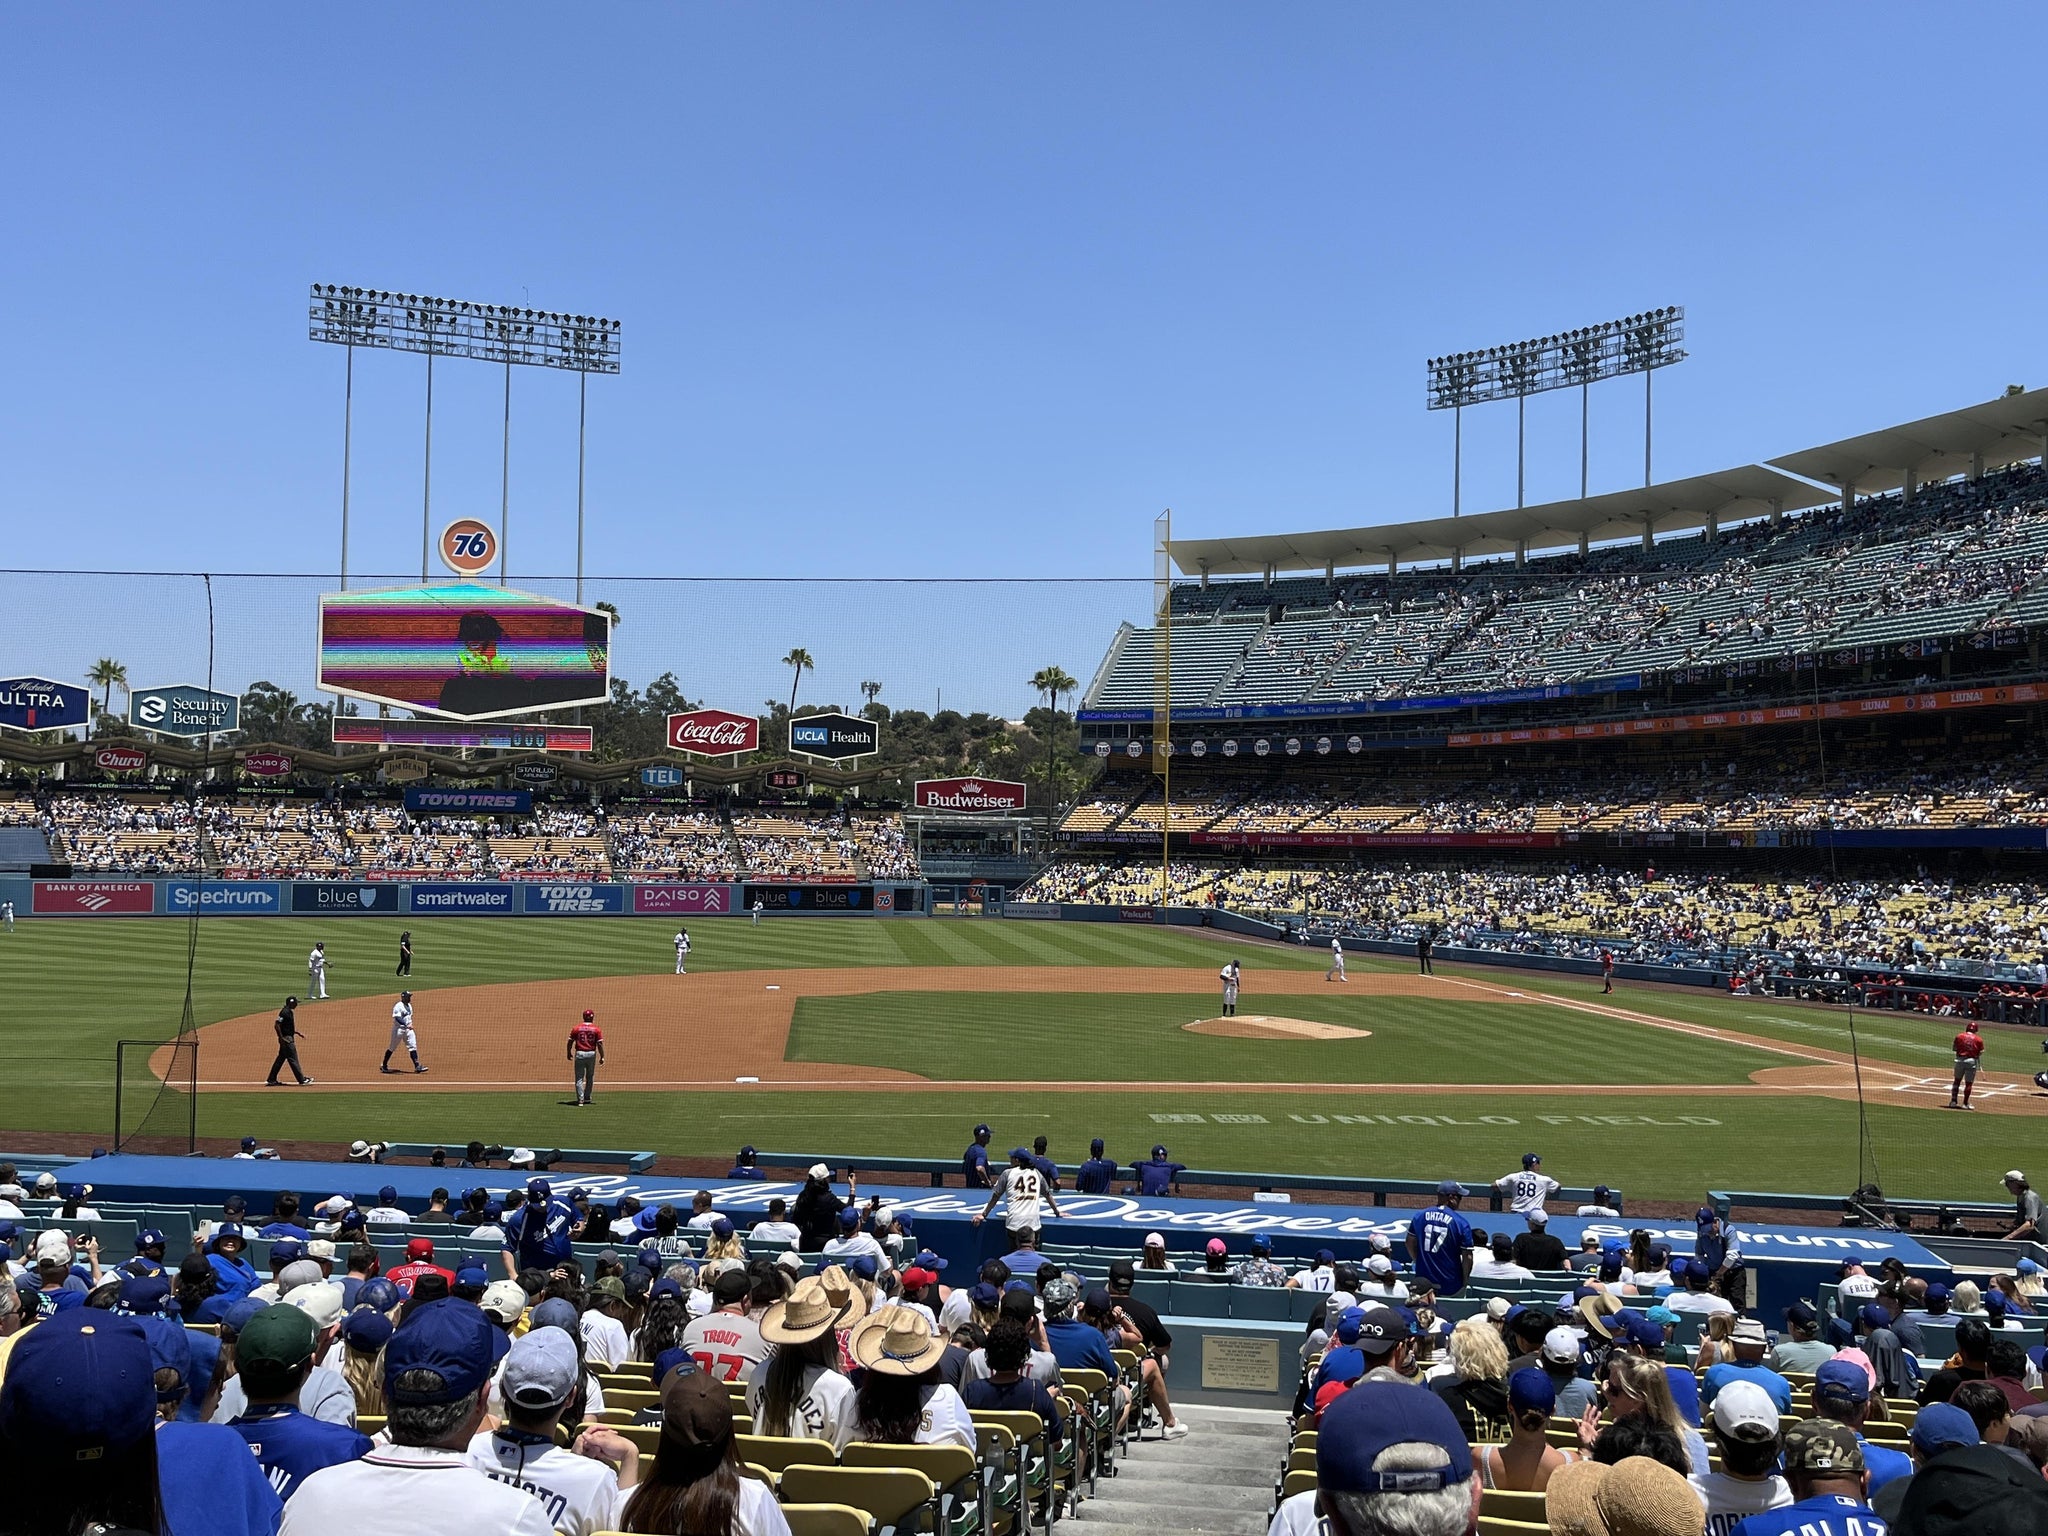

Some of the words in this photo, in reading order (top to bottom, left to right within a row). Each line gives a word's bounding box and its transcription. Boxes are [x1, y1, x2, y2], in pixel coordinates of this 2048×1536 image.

[453, 532, 488, 559] 76
[10, 680, 55, 692] Michelob
[0, 691, 65, 708] ULTRA
[172, 696, 230, 716] Security
[172, 711, 221, 726] Beneit
[676, 719, 750, 745] Coca-Cola
[796, 730, 825, 742] UCLA
[831, 730, 871, 744] Health
[98, 752, 145, 767] Churu
[247, 759, 278, 767] DAISO
[388, 761, 402, 775] JIM
[517, 766, 555, 775] STARLUX
[646, 769, 678, 783] TEL
[418, 793, 468, 807] TOYO
[468, 795, 518, 808] TIRES
[926, 791, 1015, 808] Budweiser
[1055, 832, 1071, 842] 1:10
[46, 884, 76, 892] BANK
[78, 884, 92, 892] OF
[94, 884, 141, 892] AMERICA
[318, 887, 358, 904] blue
[540, 886, 593, 899] TOYO
[644, 889, 699, 901] DAISO
[174, 887, 267, 909] Spectrum
[416, 891, 507, 906] smartwater
[755, 889, 787, 903] blue
[815, 890, 847, 904] blue
[877, 895, 892, 907] 76
[548, 898, 606, 912] TIRES
[1120, 910, 1153, 920] Yakult
[1287, 1113, 1522, 1127] UNIQLO
[1537, 1114, 1724, 1127] FIELD
[1013, 1175, 1038, 1194] 42
[1516, 1181, 1537, 1198] 88
[1424, 1211, 1453, 1225] OHTANI
[1424, 1224, 1449, 1254] 17
[1587, 1223, 1876, 1250] Spetrum
[1314, 1276, 1330, 1292] 17
[1848, 1282, 1879, 1297] FREEM
[1358, 1322, 1384, 1337] ping
[702, 1328, 742, 1348] TROUT
